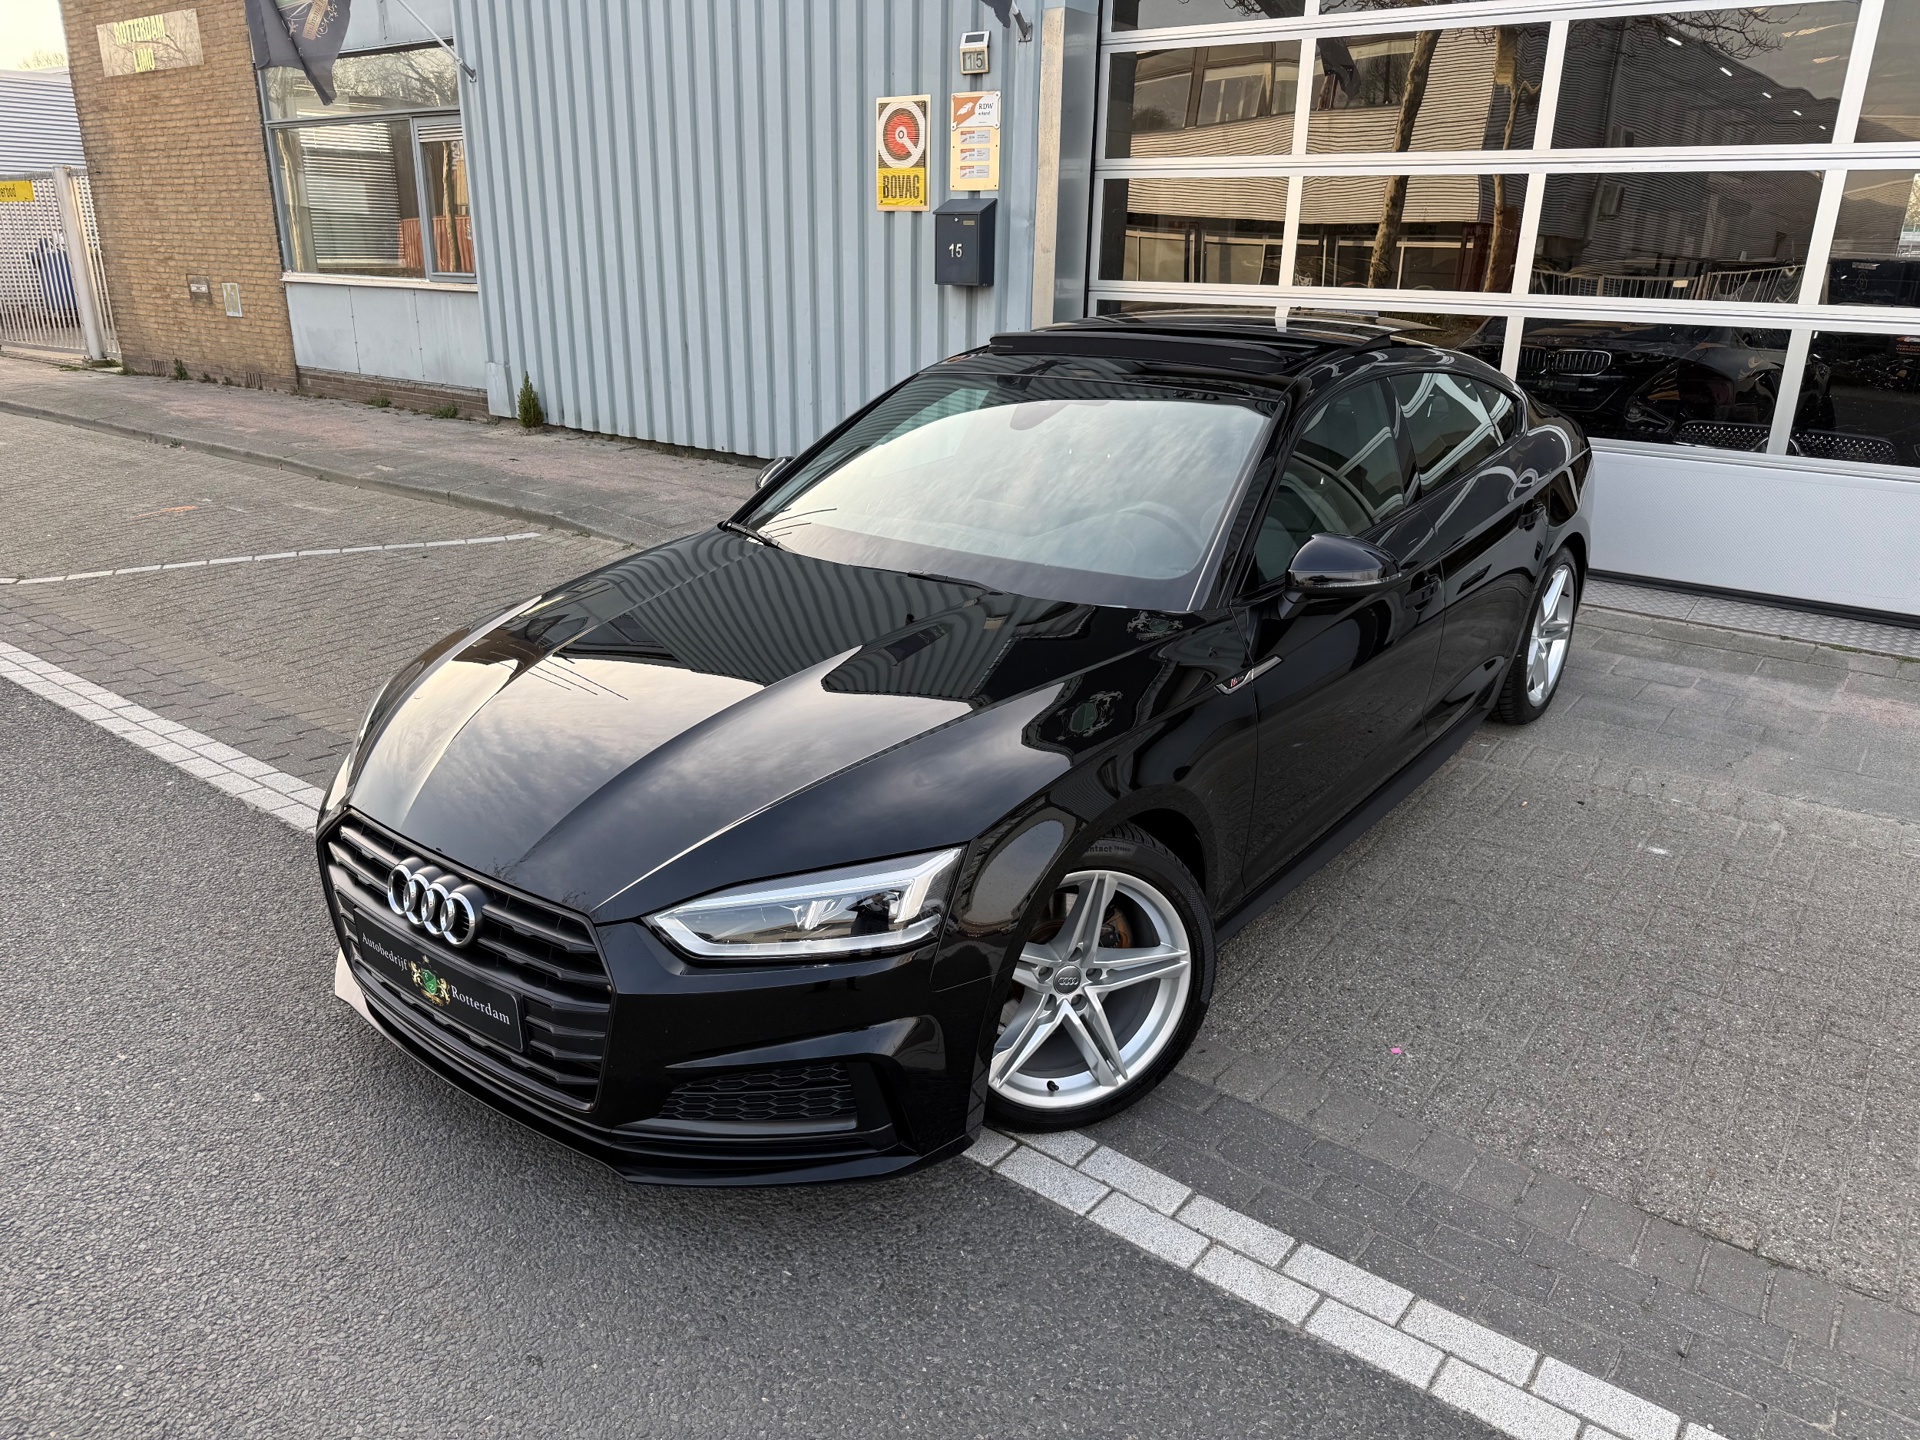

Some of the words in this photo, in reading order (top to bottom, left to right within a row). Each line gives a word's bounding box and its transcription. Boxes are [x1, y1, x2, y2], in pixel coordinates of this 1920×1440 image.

[114, 14, 165, 45] ROTTERDAM
[967, 52, 984, 69] 15
[978, 102, 994, 110] RDW
[883, 175, 920, 199] BOVAG
[948, 243, 963, 258] 15
[362, 932, 408, 972] Autobedrijf
[450, 984, 511, 1026] Rotterdam
